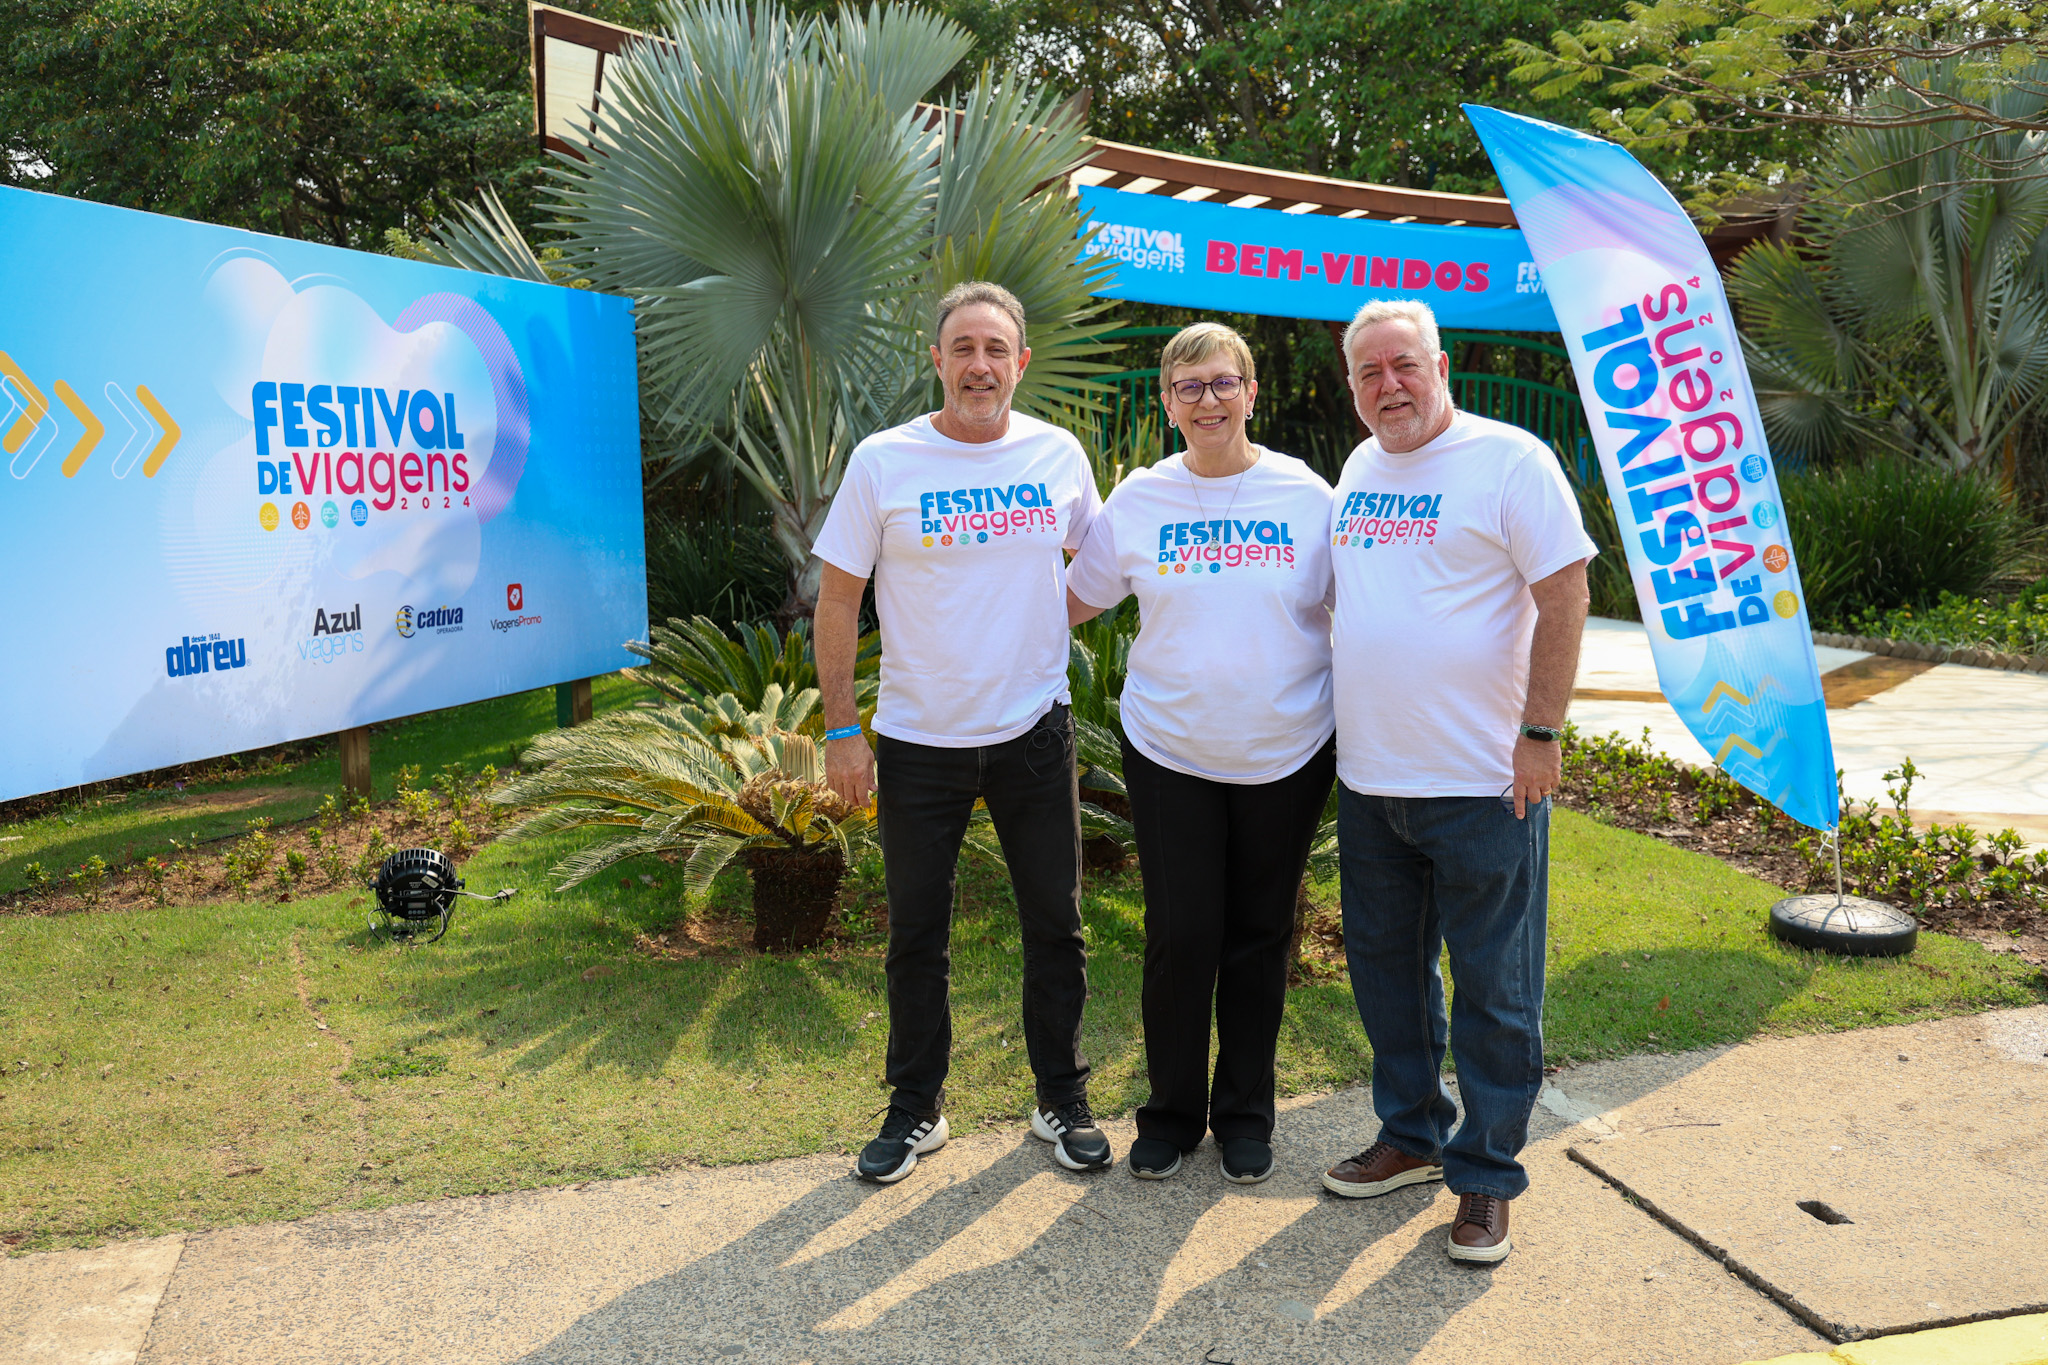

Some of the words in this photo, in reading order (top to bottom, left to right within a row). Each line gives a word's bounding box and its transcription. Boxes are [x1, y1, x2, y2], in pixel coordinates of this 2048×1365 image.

[1205, 239, 1490, 293] BEM-VINDOS
[1686, 275, 1734, 402] 2024
[257, 461, 292, 495] DE
[400, 495, 470, 510] 2024
[921, 519, 943, 534] DE
[1011, 526, 1058, 535] 2024
[1335, 519, 1349, 533] DE
[1391, 538, 1434, 546] 2024
[1158, 550, 1178, 563] DE
[1244, 560, 1296, 570] 2024
[1731, 574, 1770, 627] DE
[313, 603, 362, 637] Azul
[416, 605, 464, 629] cativa
[436, 626, 464, 635] OPERADORA
[191, 634, 207, 643] desde
[297, 632, 365, 664] viagens
[166, 636, 246, 678] abreu
